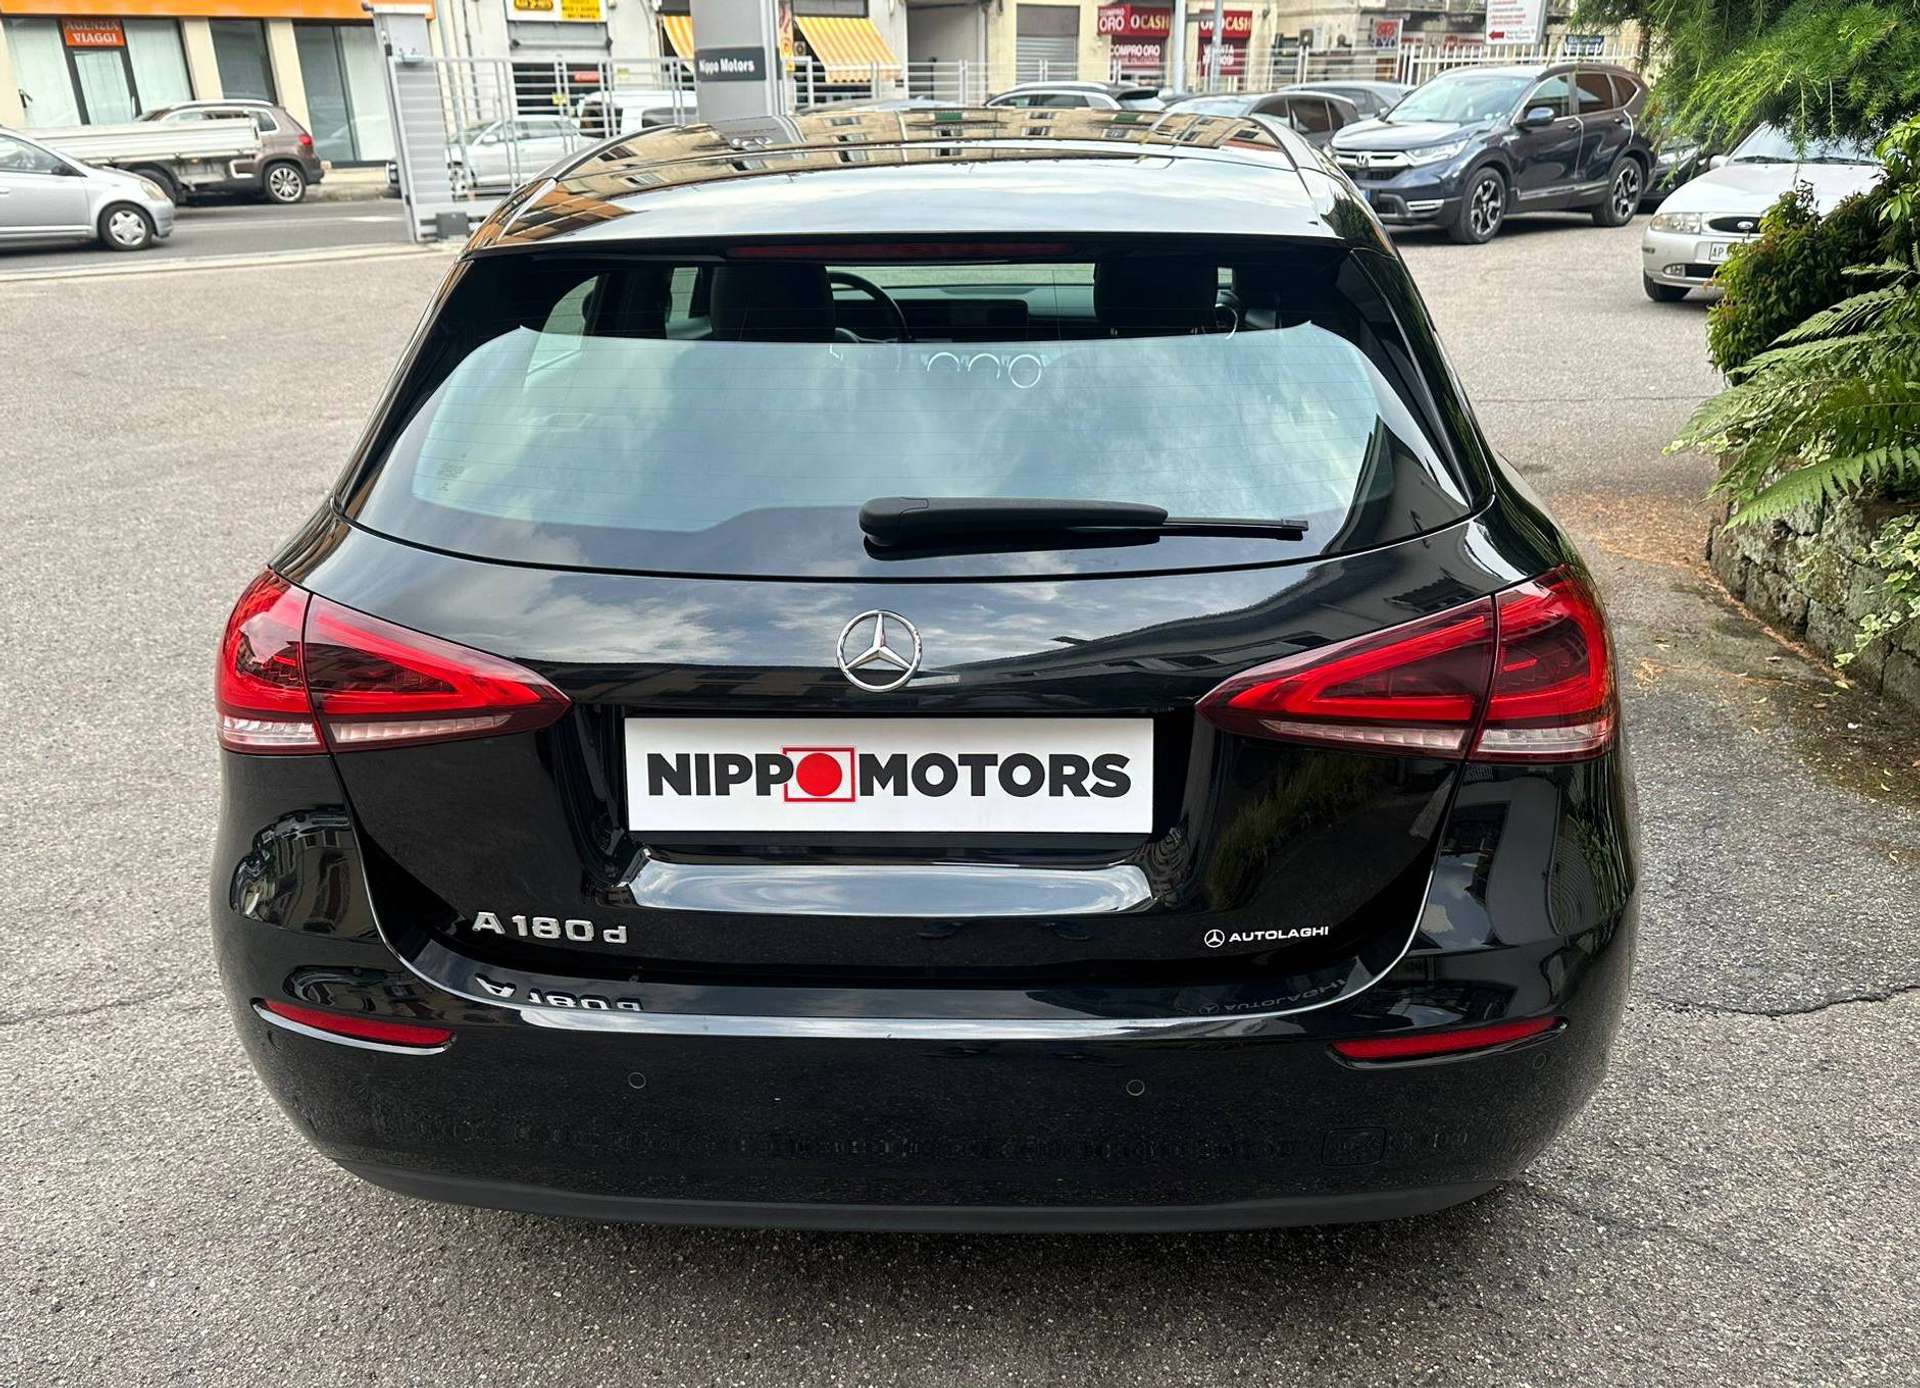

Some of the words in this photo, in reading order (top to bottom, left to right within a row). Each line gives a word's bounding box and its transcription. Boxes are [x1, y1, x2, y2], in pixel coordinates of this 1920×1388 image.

[66, 21, 120, 30] AGENZIA
[1099, 16, 1125, 31] ORO
[73, 32, 117, 43] VIAGGI
[720, 58, 754, 73] Motors
[472, 911, 506, 934] A
[511, 914, 595, 942] 180
[603, 925, 628, 944] d
[1228, 926, 1329, 942] AUTOLAGHI
